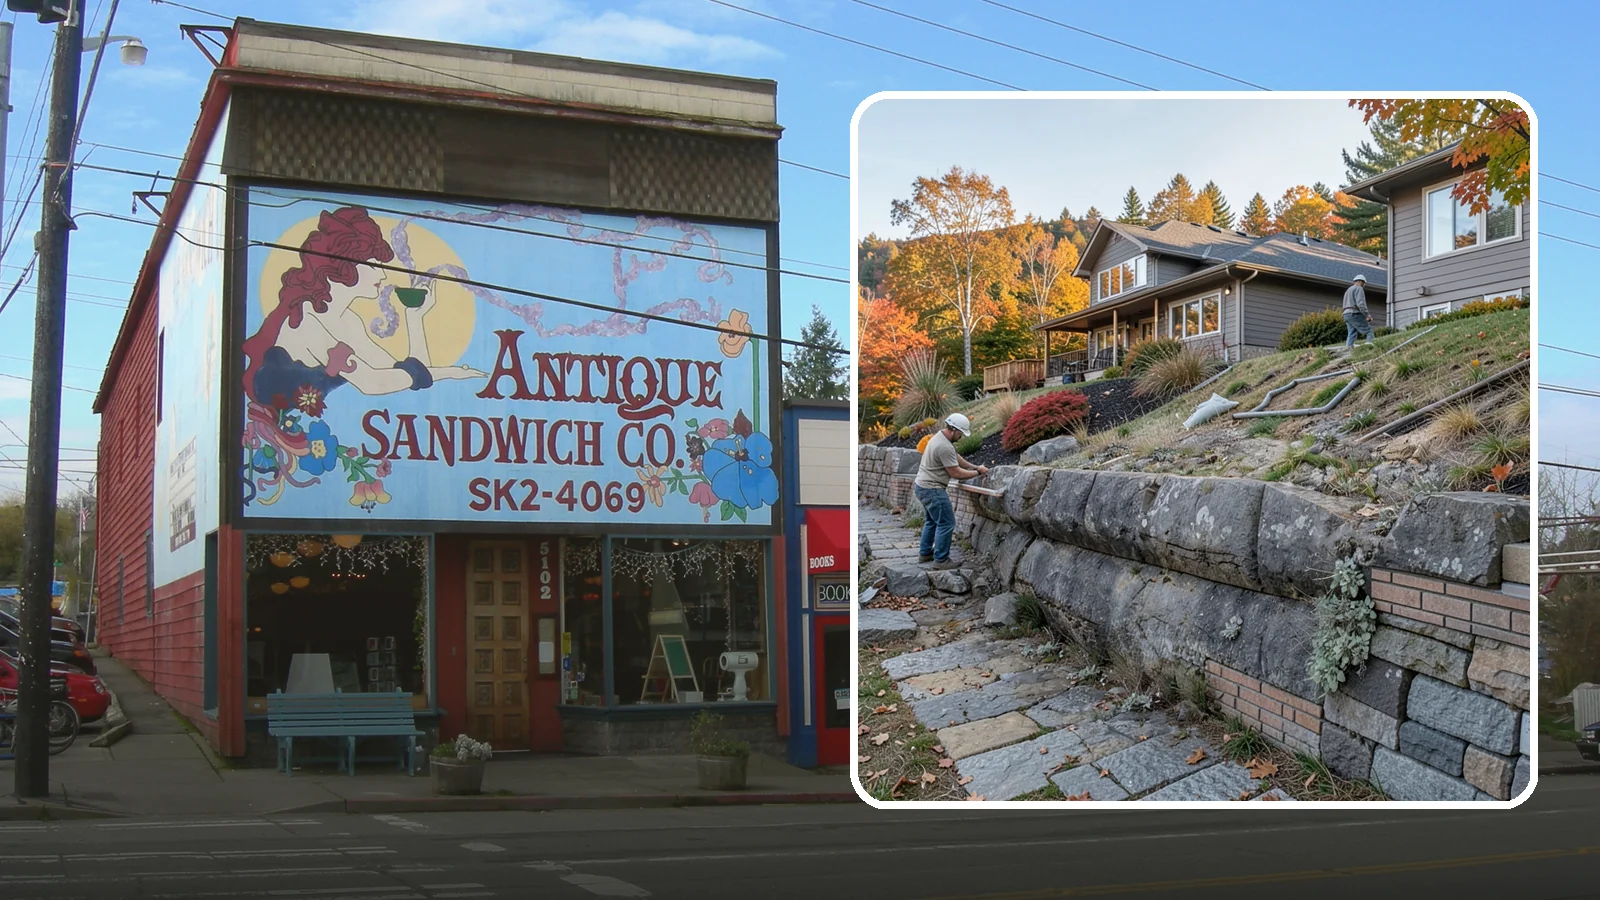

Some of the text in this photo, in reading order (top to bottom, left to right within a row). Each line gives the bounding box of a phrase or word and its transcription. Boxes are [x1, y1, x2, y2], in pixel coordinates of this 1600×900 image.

[476, 329, 723, 420] ANTIQUE
[362, 409, 685, 469] SANDWICH CO.
[468, 476, 646, 513] SK2-4069
[540, 541, 551, 600] 5102
[810, 555, 834, 569] BOOKS
